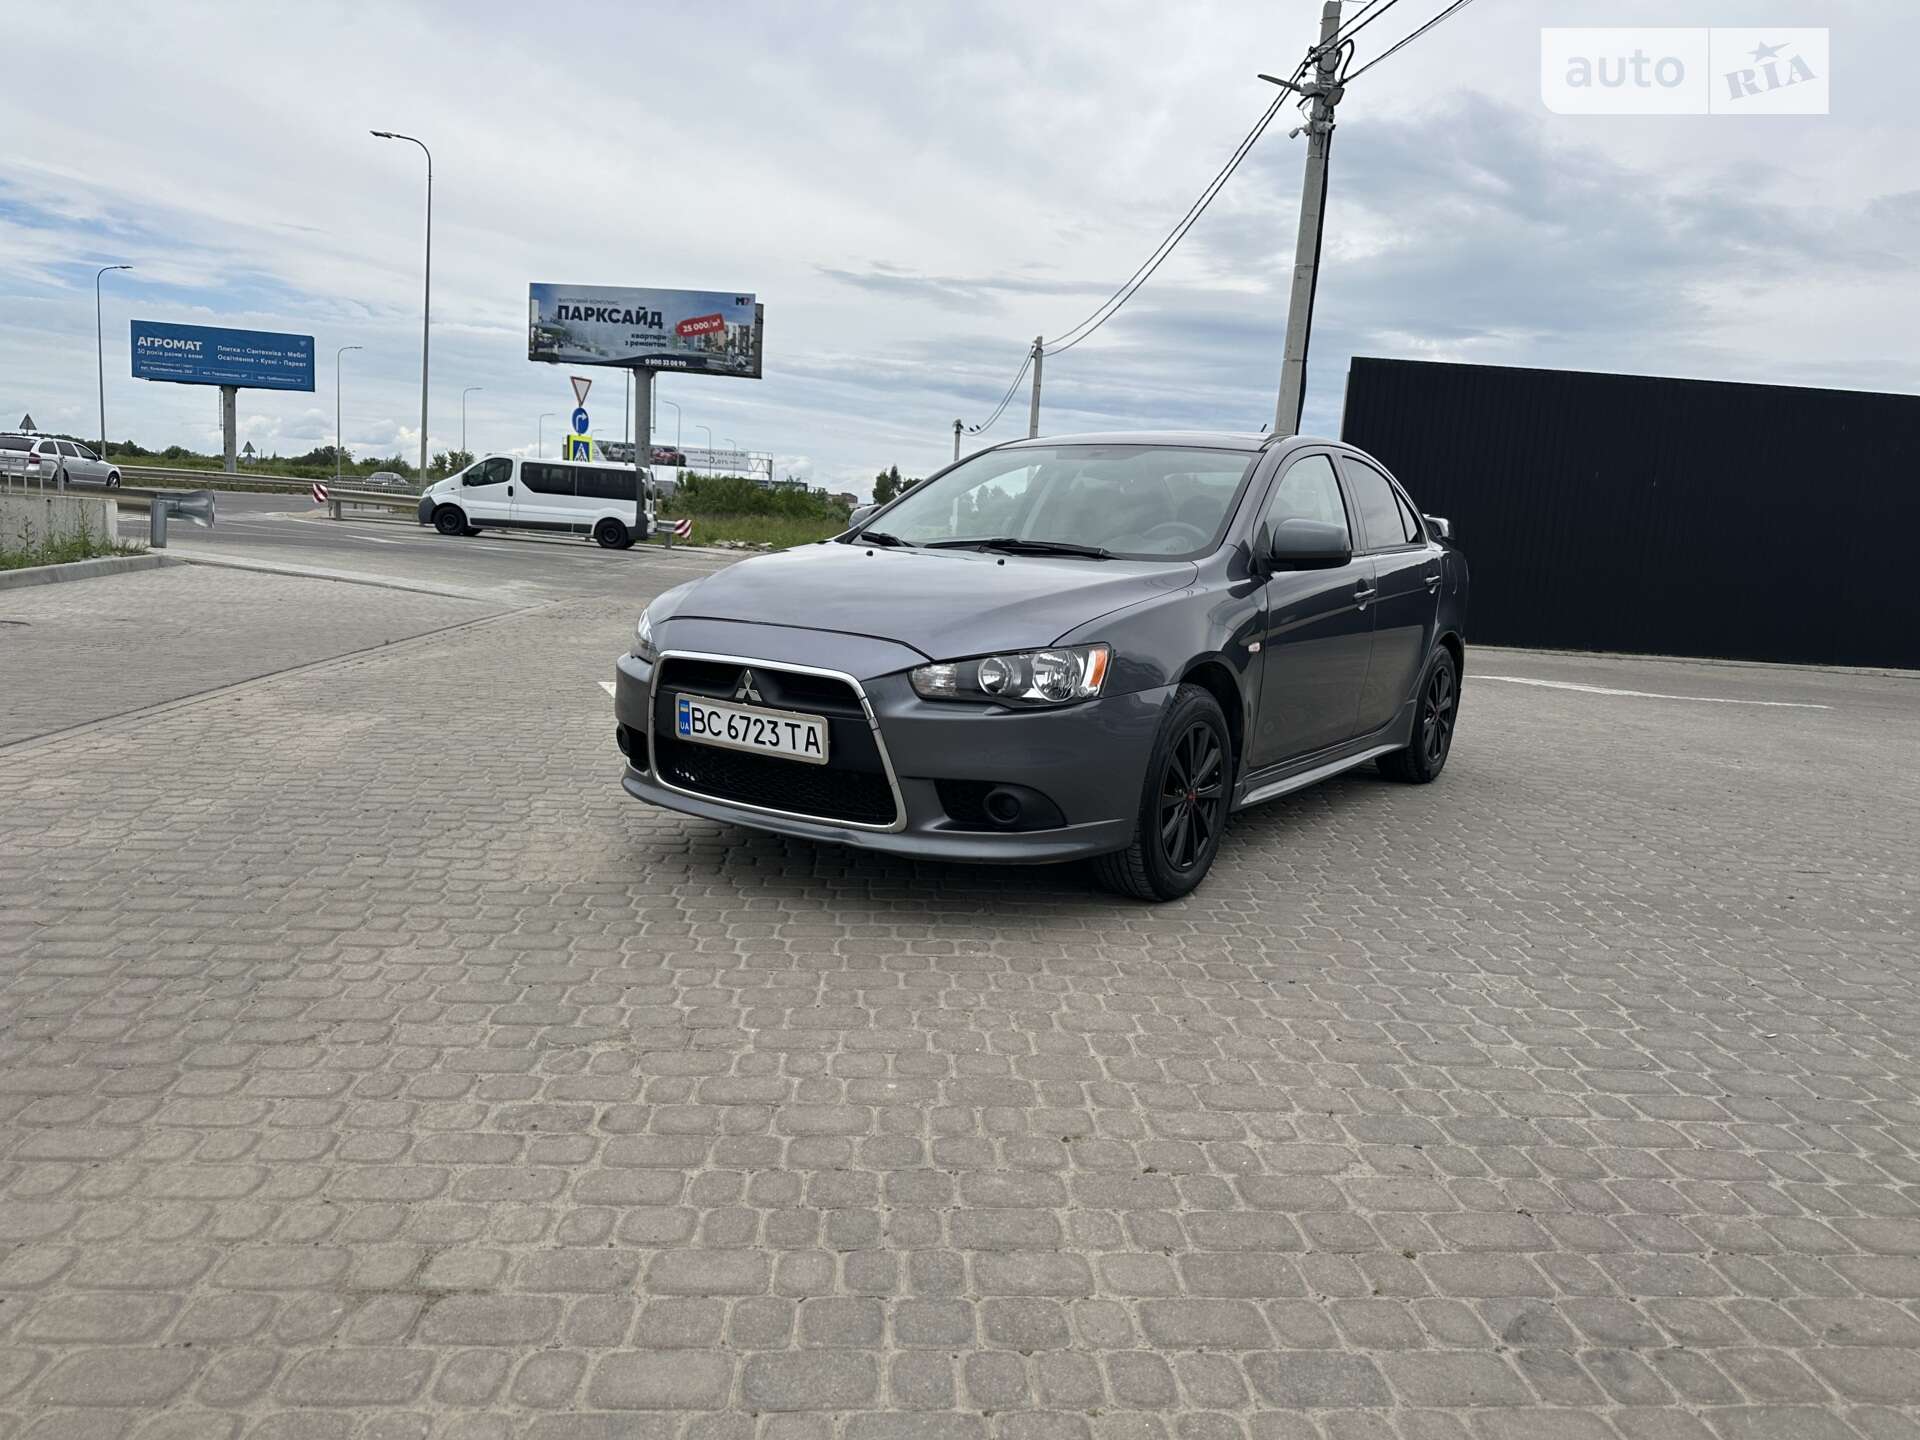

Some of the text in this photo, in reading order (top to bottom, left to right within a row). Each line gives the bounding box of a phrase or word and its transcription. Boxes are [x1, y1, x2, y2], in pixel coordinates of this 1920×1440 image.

[557, 304, 663, 329] ПАРКСАЙД
[137, 336, 203, 351] АГРОМАТ
[217, 345, 241, 353] Плитка
[246, 348, 282, 357] Сантехніка
[217, 354, 255, 363] Освітлення
[680, 721, 690, 730] UA
[691, 706, 821, 754] BC 6723 TA
